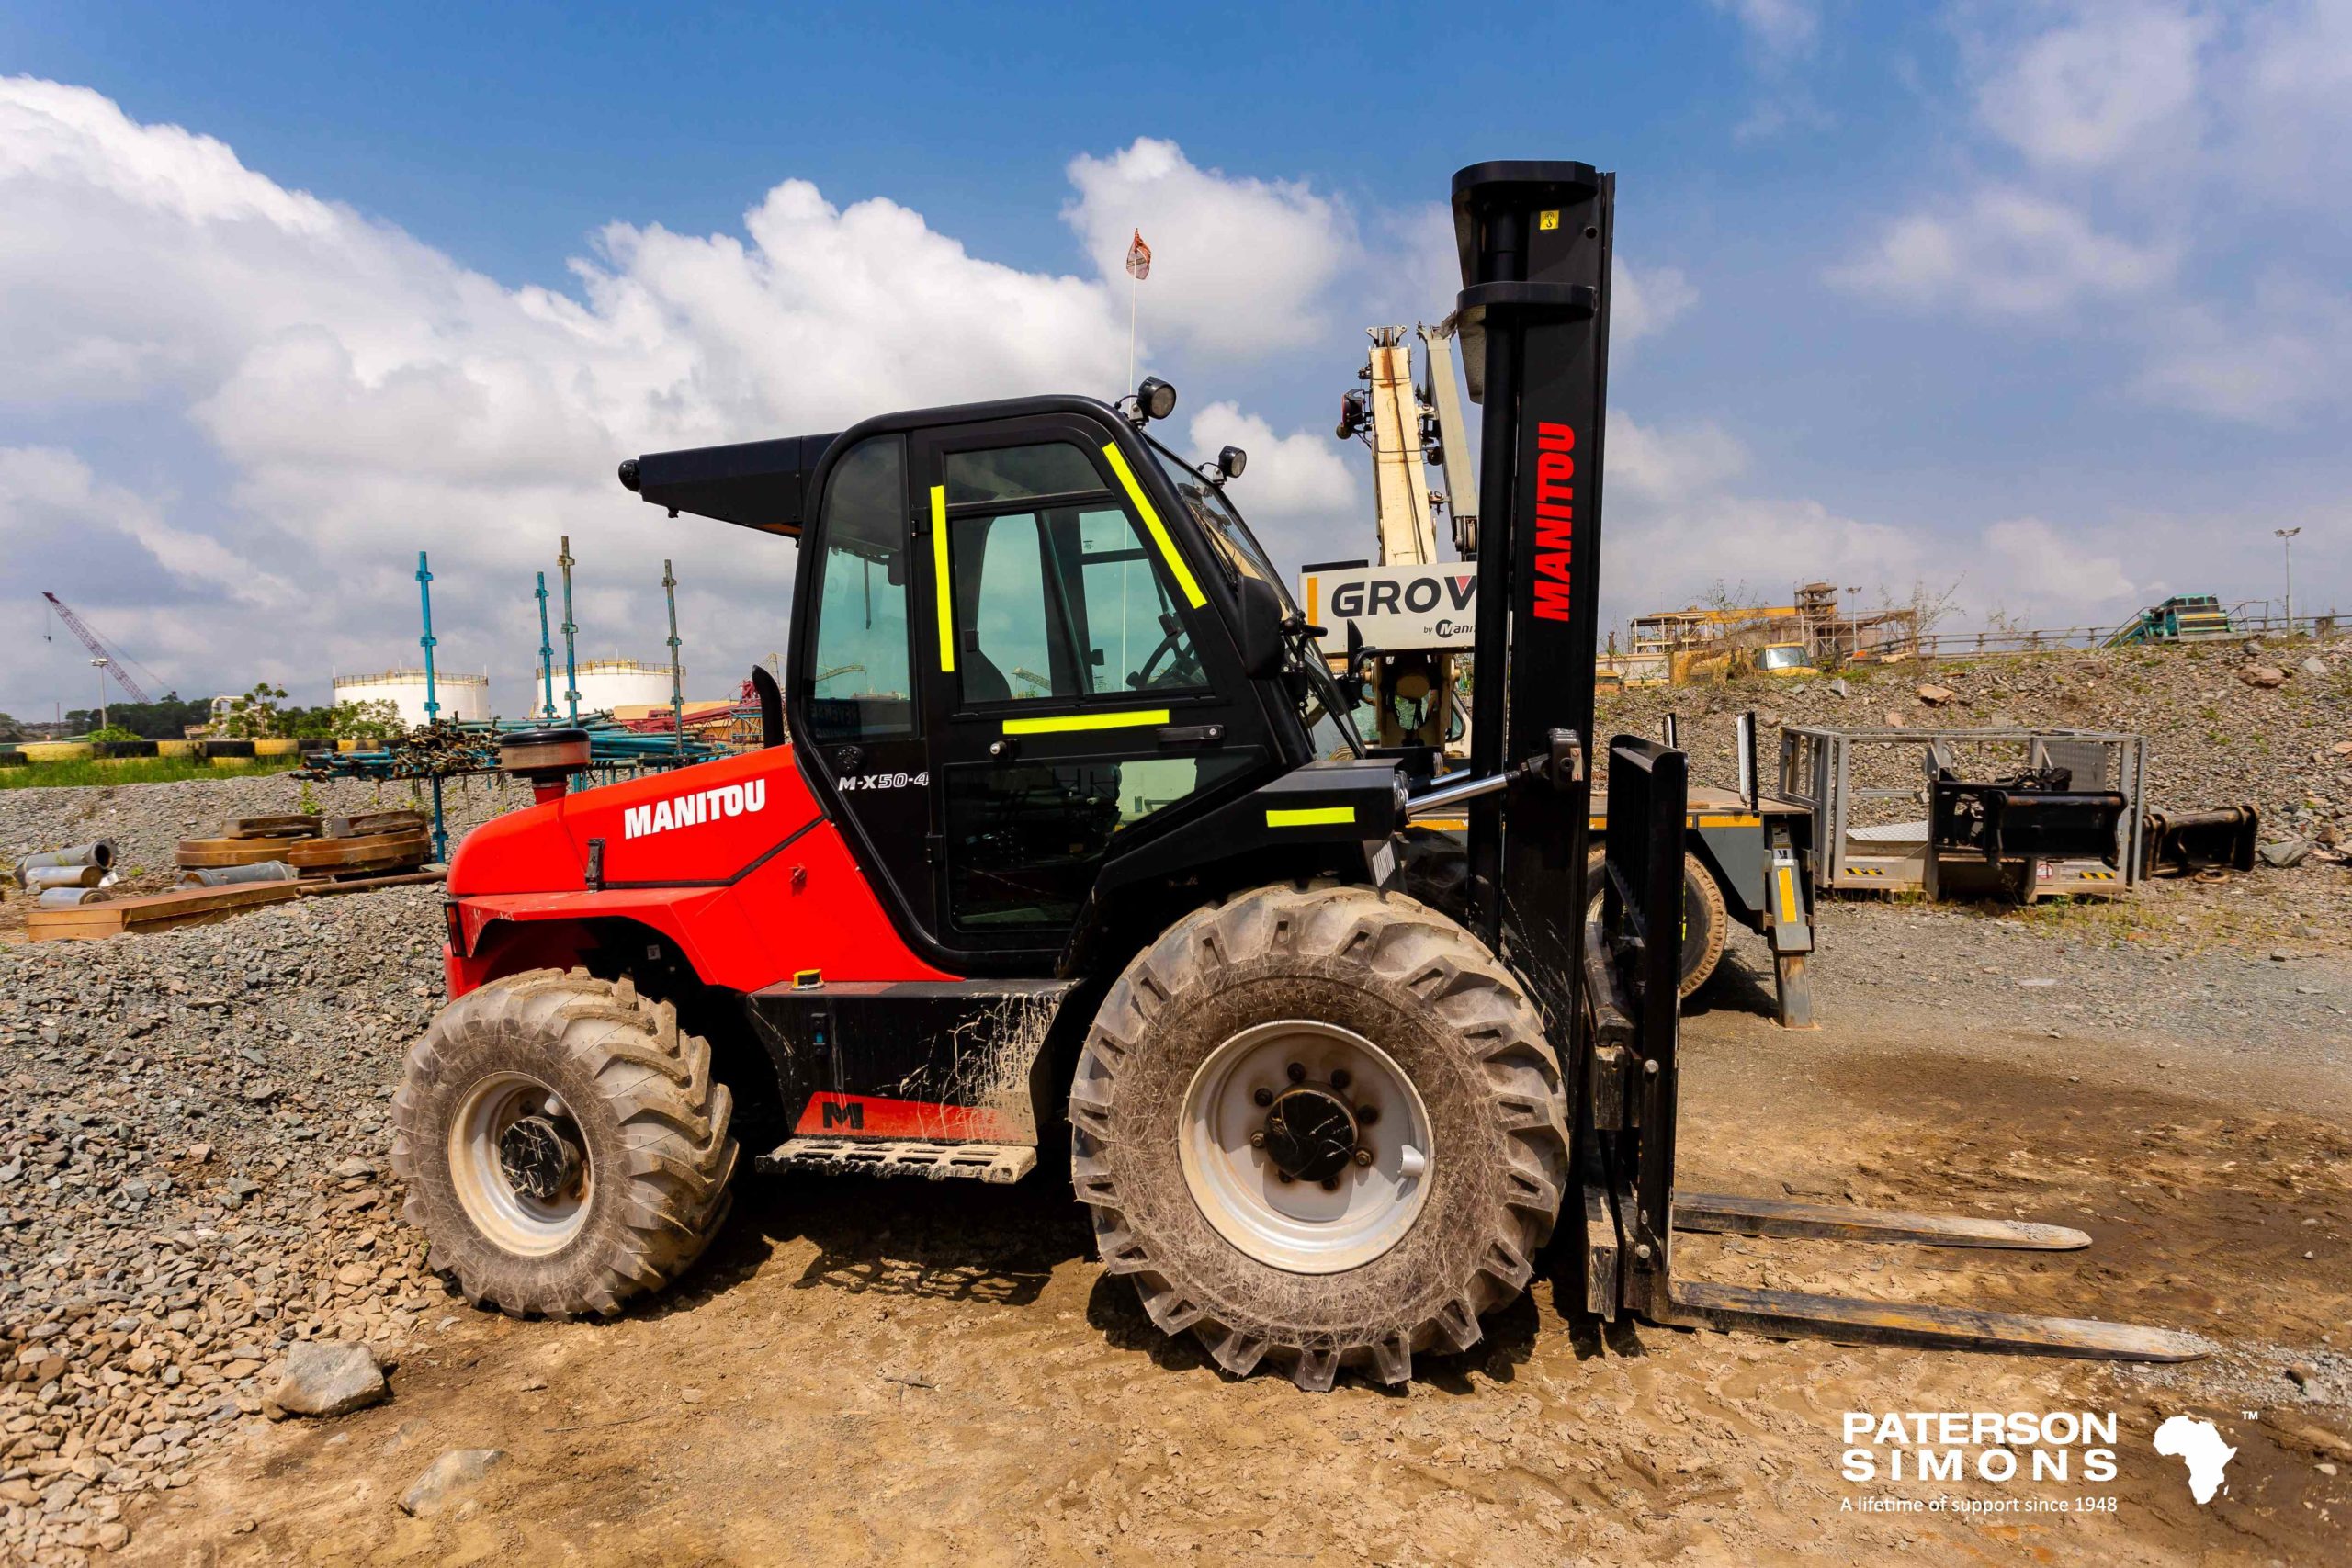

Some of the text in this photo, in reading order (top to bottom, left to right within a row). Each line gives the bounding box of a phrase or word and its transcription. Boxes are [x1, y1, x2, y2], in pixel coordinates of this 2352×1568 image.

[1534, 423, 1574, 620] MANITOU
[1423, 626, 1433, 636] by
[837, 772, 929, 792] M-X50-4
[625, 779, 765, 840] MANITOU
[822, 1101, 864, 1130] M
